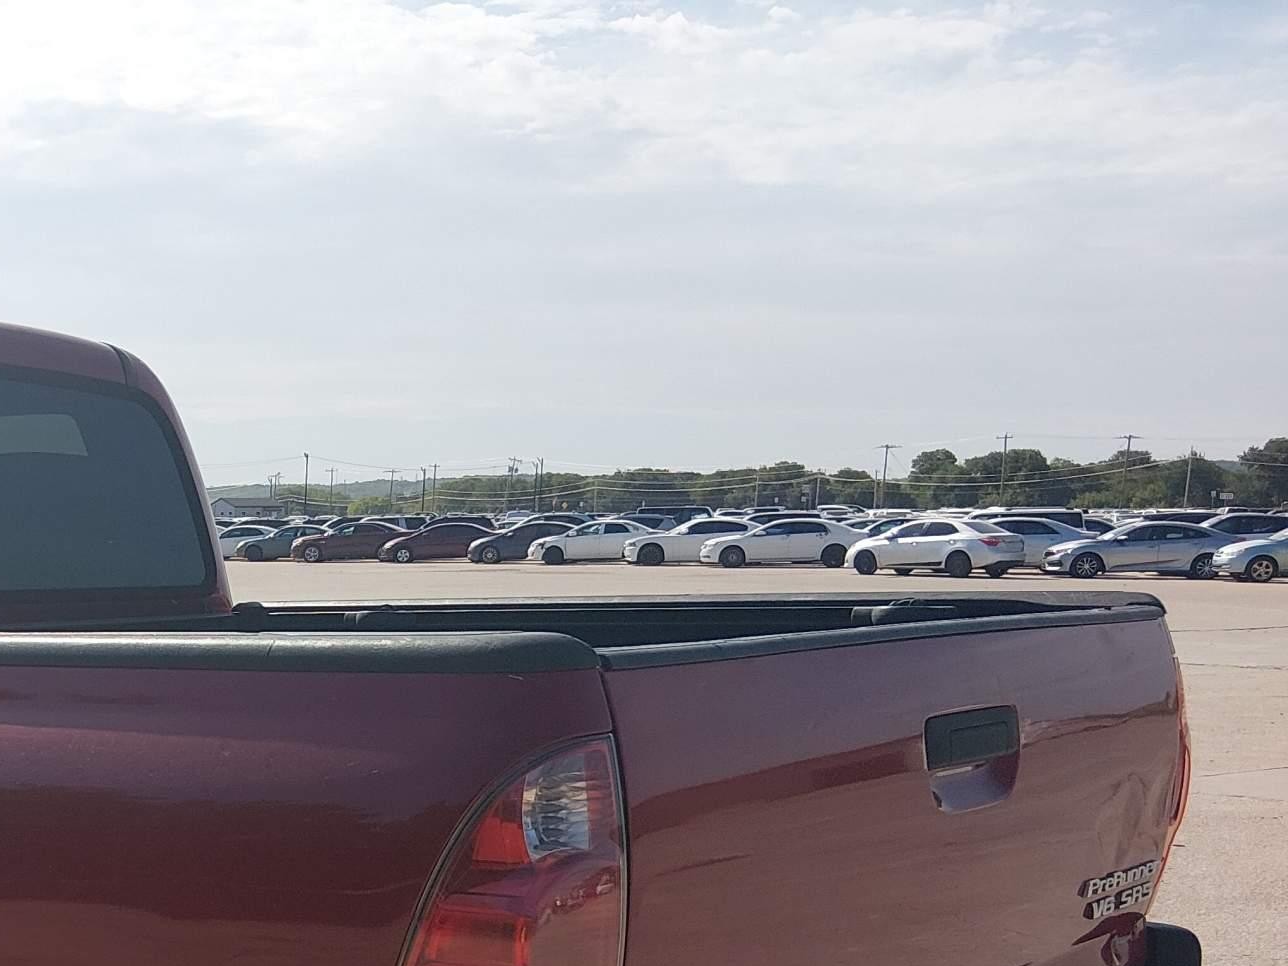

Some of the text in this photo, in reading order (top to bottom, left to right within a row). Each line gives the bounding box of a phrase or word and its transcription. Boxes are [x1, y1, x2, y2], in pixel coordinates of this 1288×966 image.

[1087, 861, 1160, 897] PreRunner
[1092, 883, 1153, 919] V6 SR5
